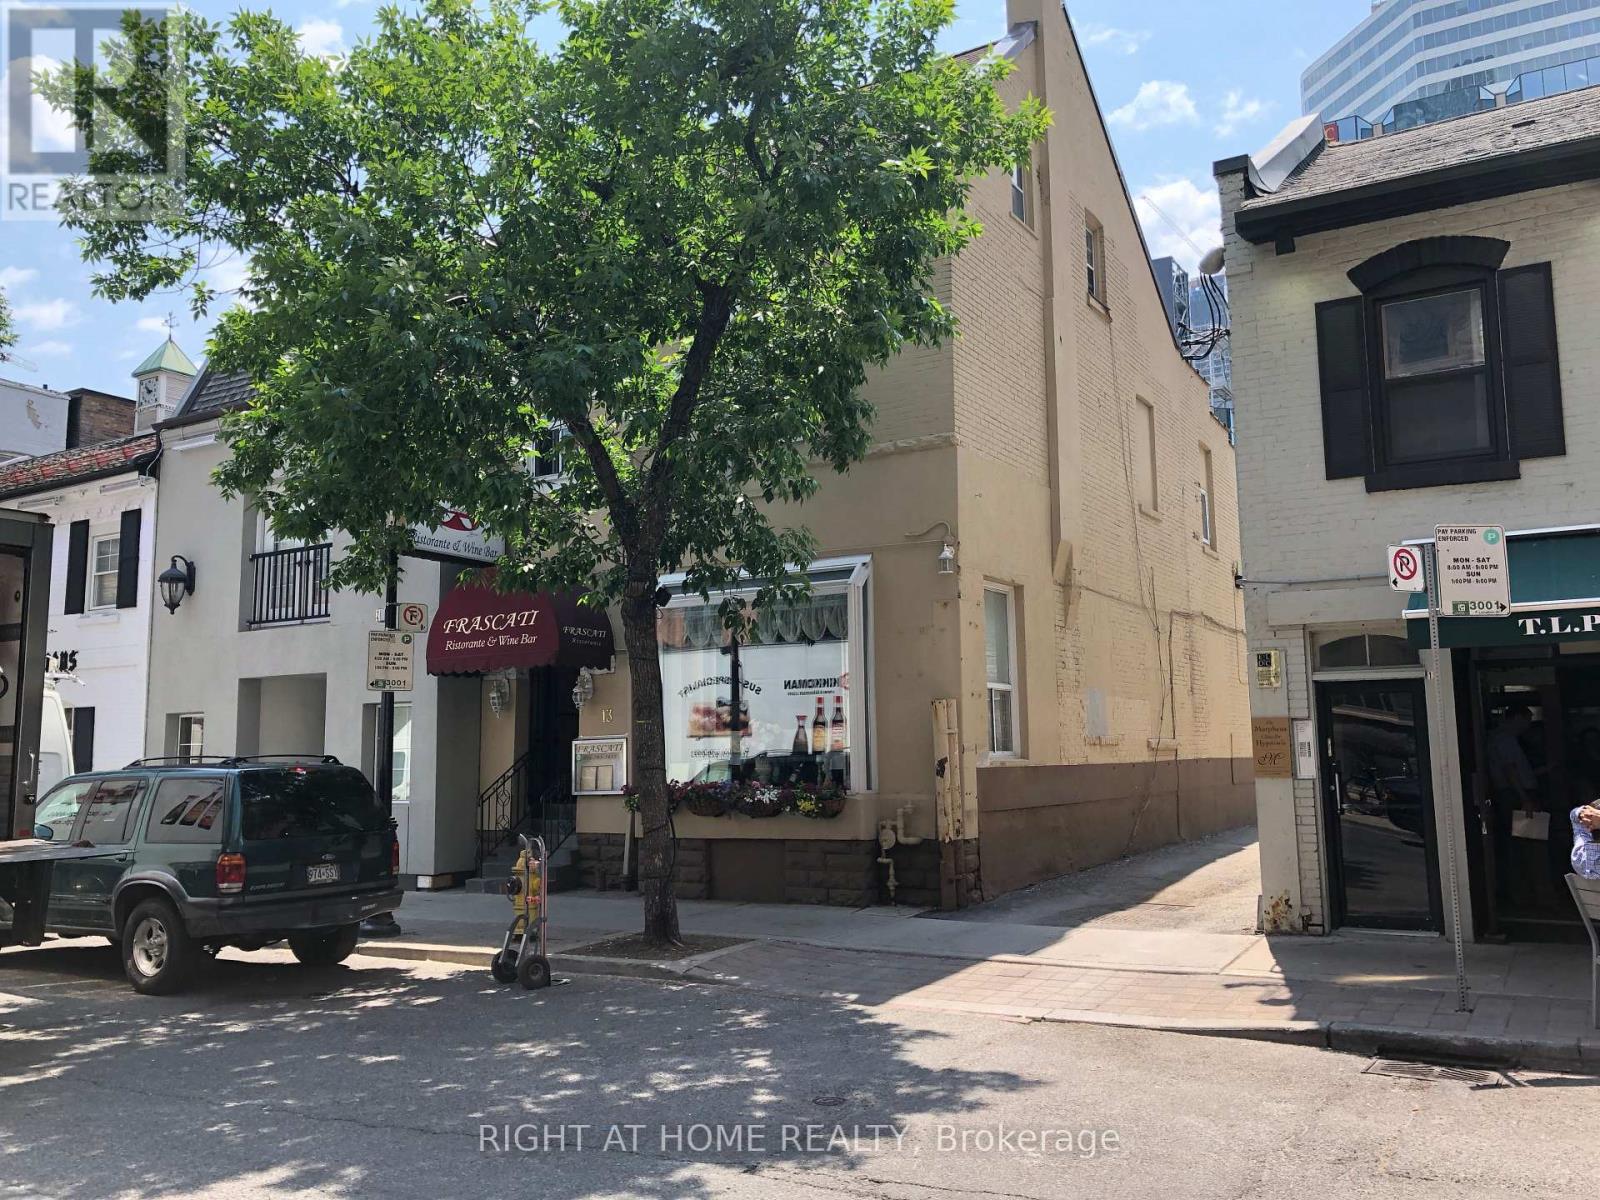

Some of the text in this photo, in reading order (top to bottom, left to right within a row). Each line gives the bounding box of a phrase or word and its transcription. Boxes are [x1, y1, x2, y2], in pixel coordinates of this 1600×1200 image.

[452, 540, 461, 552] &
[464, 541, 481, 556] Wine
[483, 545, 498, 558] Bar
[1470, 601, 1500, 610] 3001
[443, 609, 540, 634] FRASCATI
[445, 633, 538, 651] Ristorante & Wine Bar
[601, 709, 613, 723] 13
